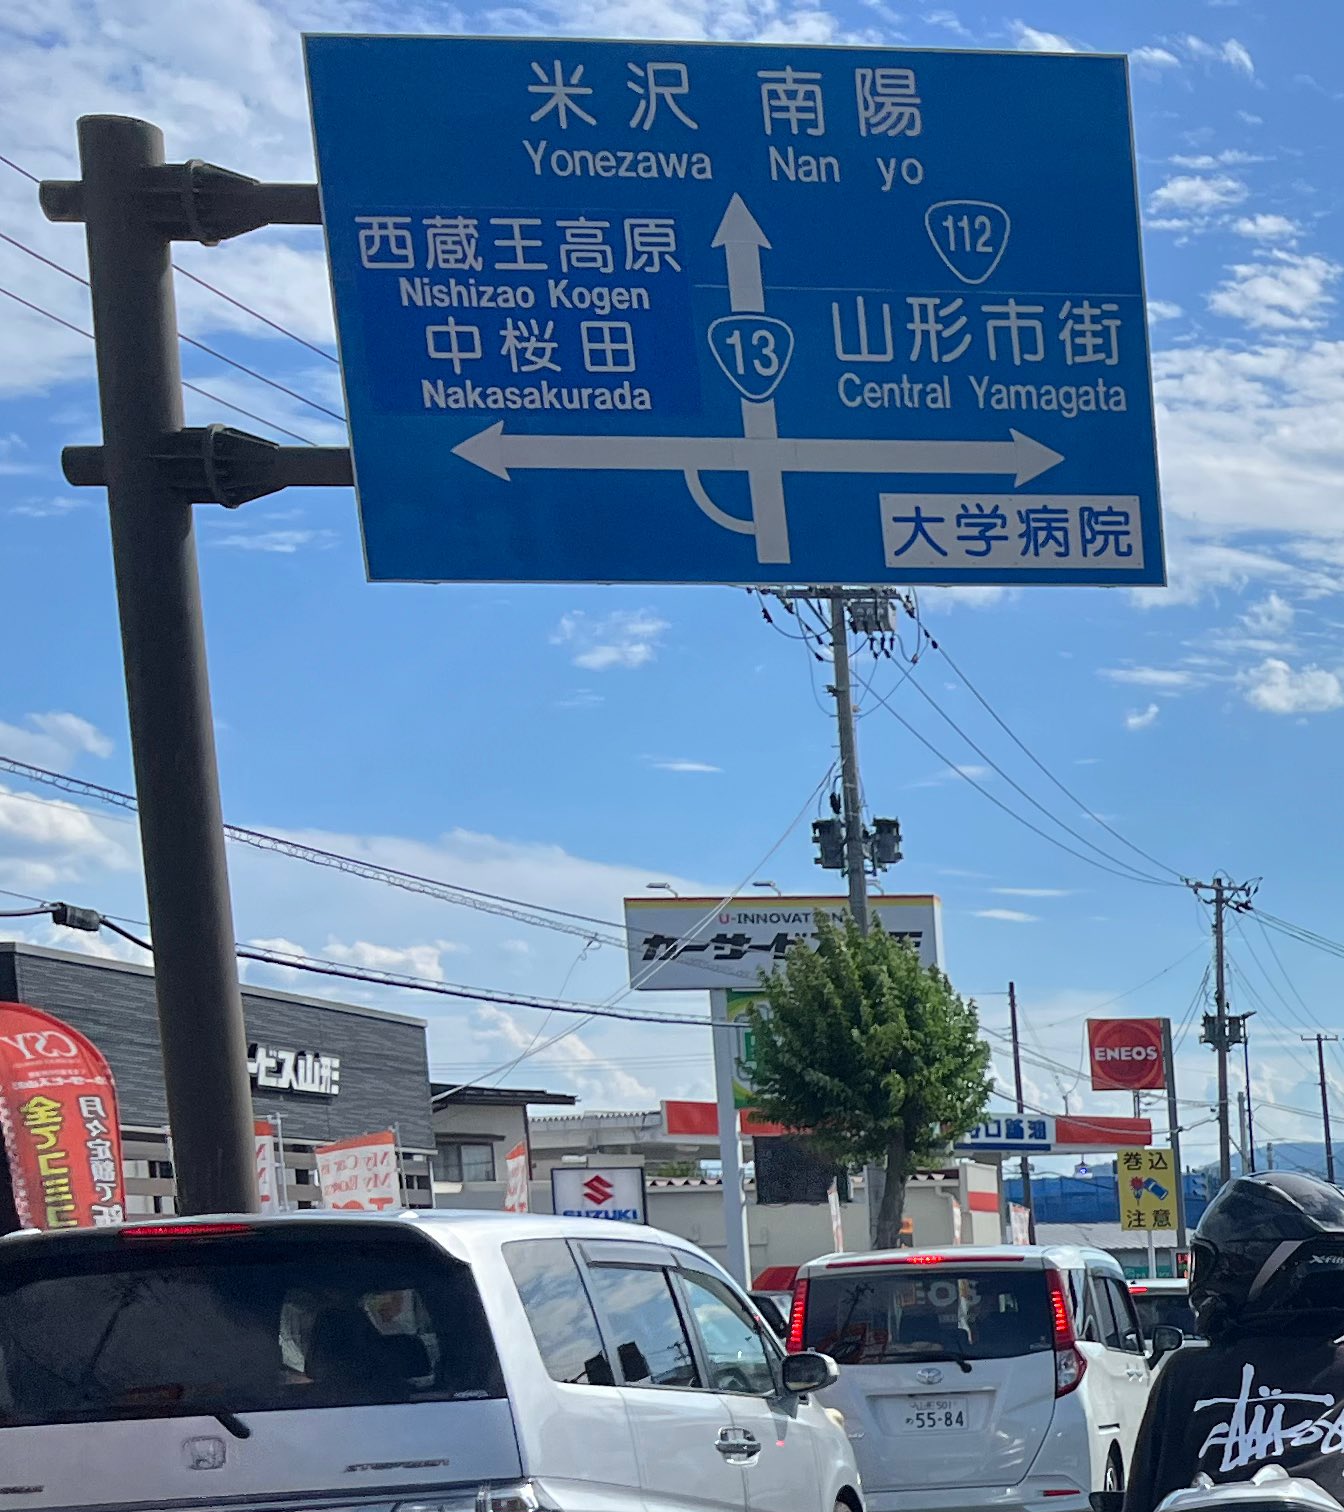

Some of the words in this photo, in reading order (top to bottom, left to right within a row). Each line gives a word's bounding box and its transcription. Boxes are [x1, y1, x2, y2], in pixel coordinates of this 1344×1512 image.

[525, 60, 699, 131] 米沢
[756, 66, 924, 138] 南陽
[522, 139, 713, 182] Yonezawa
[769, 145, 841, 184] Nan
[877, 153, 925, 192] yo
[354, 215, 683, 276] 西蔵王高原
[941, 214, 994, 254] 112
[399, 277, 536, 310] Nishizao
[548, 280, 651, 316] Kogen
[423, 317, 635, 375] 中桜田
[832, 296, 1123, 368] 山形市街
[724, 329, 780, 379] 13
[421, 379, 653, 412] Nakasakurada
[837, 374, 951, 411] Central
[968, 376, 1129, 418] Yamagata
[890, 504, 1135, 560] 大学病院
[718, 912, 844, 924] U-INNOVATN
[642, 931, 923, 961] カーサービ
[1094, 1046, 1158, 1061] ENEOS
[1123, 1152, 1168, 1171] 巻込
[1127, 1209, 1172, 1228] 注意
